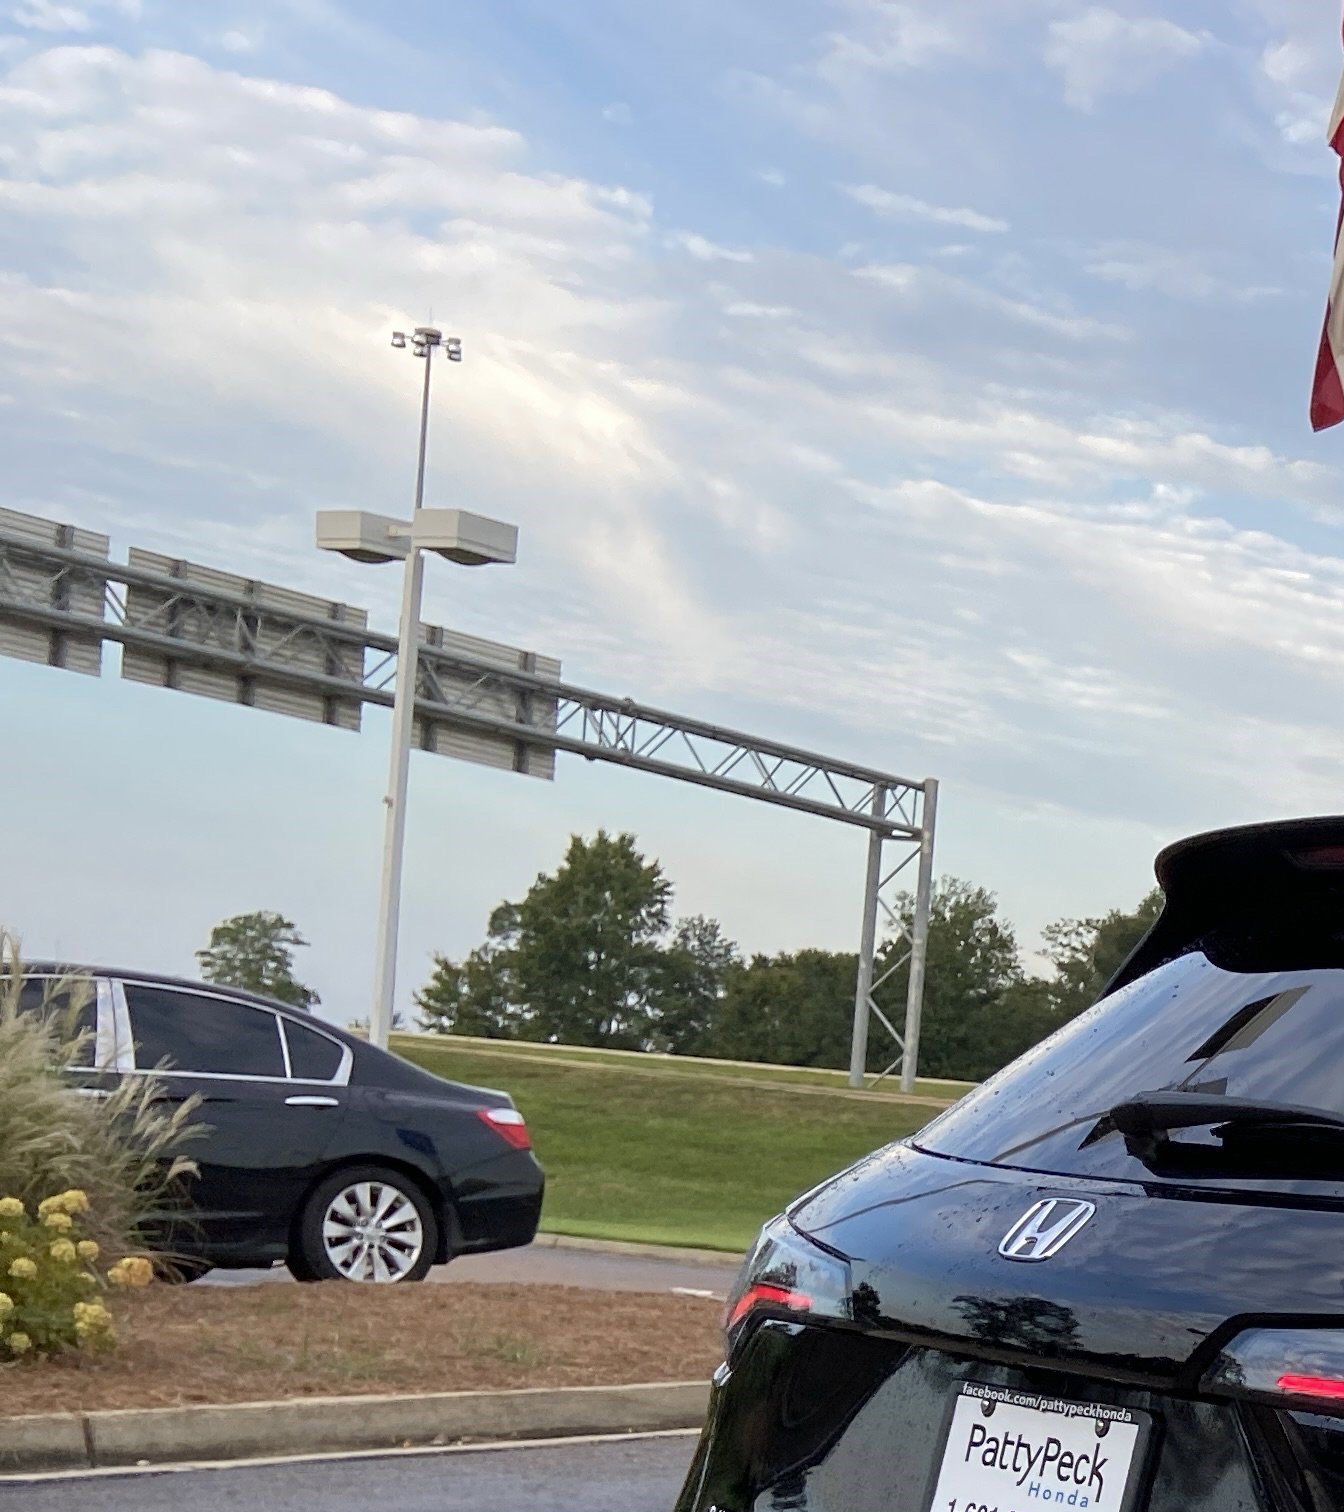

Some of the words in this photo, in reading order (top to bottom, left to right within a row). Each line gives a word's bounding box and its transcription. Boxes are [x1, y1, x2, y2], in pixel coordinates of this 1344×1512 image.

[962, 1382, 1132, 1422] facebook.com/pattypeckhonda
[965, 1423, 1108, 1503] PattyPeck
[1027, 1481, 1089, 1508] Honda
